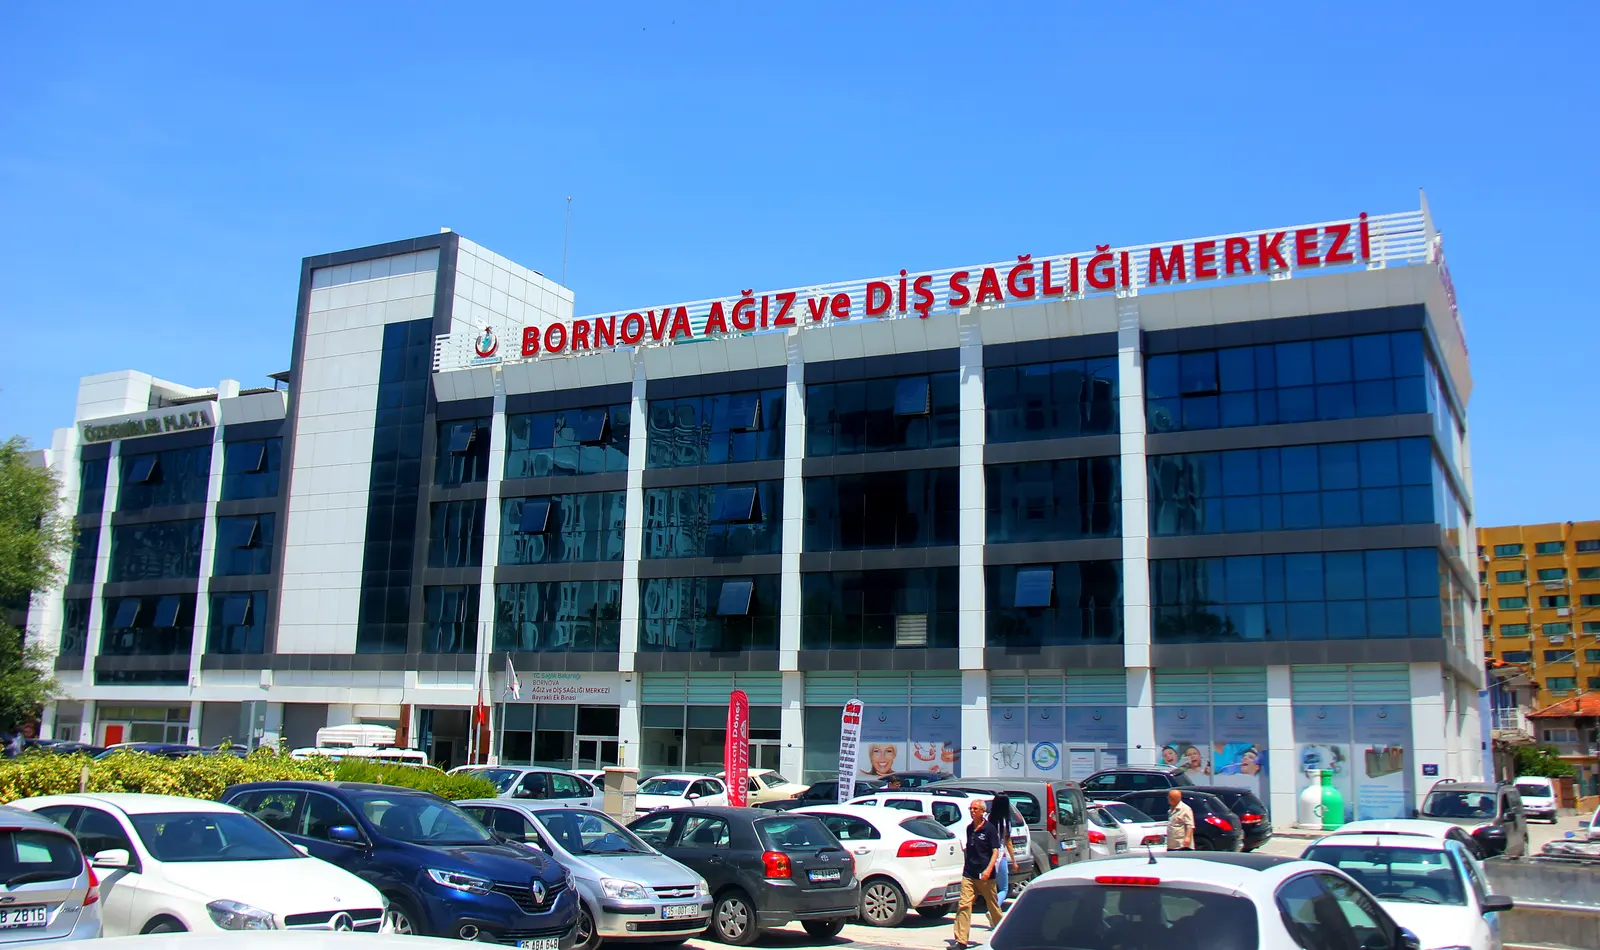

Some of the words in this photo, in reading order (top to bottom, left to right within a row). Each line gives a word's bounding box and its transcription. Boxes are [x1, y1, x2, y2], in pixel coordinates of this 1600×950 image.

[521, 305, 693, 357] BORNOVA
[704, 289, 797, 335] AĞIZ
[807, 292, 851, 321] ve
[865, 268, 935, 319] DİŞ
[949, 244, 1131, 306] SAĞLIĞI
[1149, 212, 1370, 284] MERKEZİ
[163, 410, 209, 432] PLAZA
[552, 686, 563, 694] DİŞ
[562, 686, 585, 694] SAĞLIĞI
[585, 686, 611, 694] MERKEZİ
[732, 701, 741, 738] Döner
[739, 741, 747, 764] 777
[738, 777, 747, 803] 400
[14, 908, 45, 923] 2816
